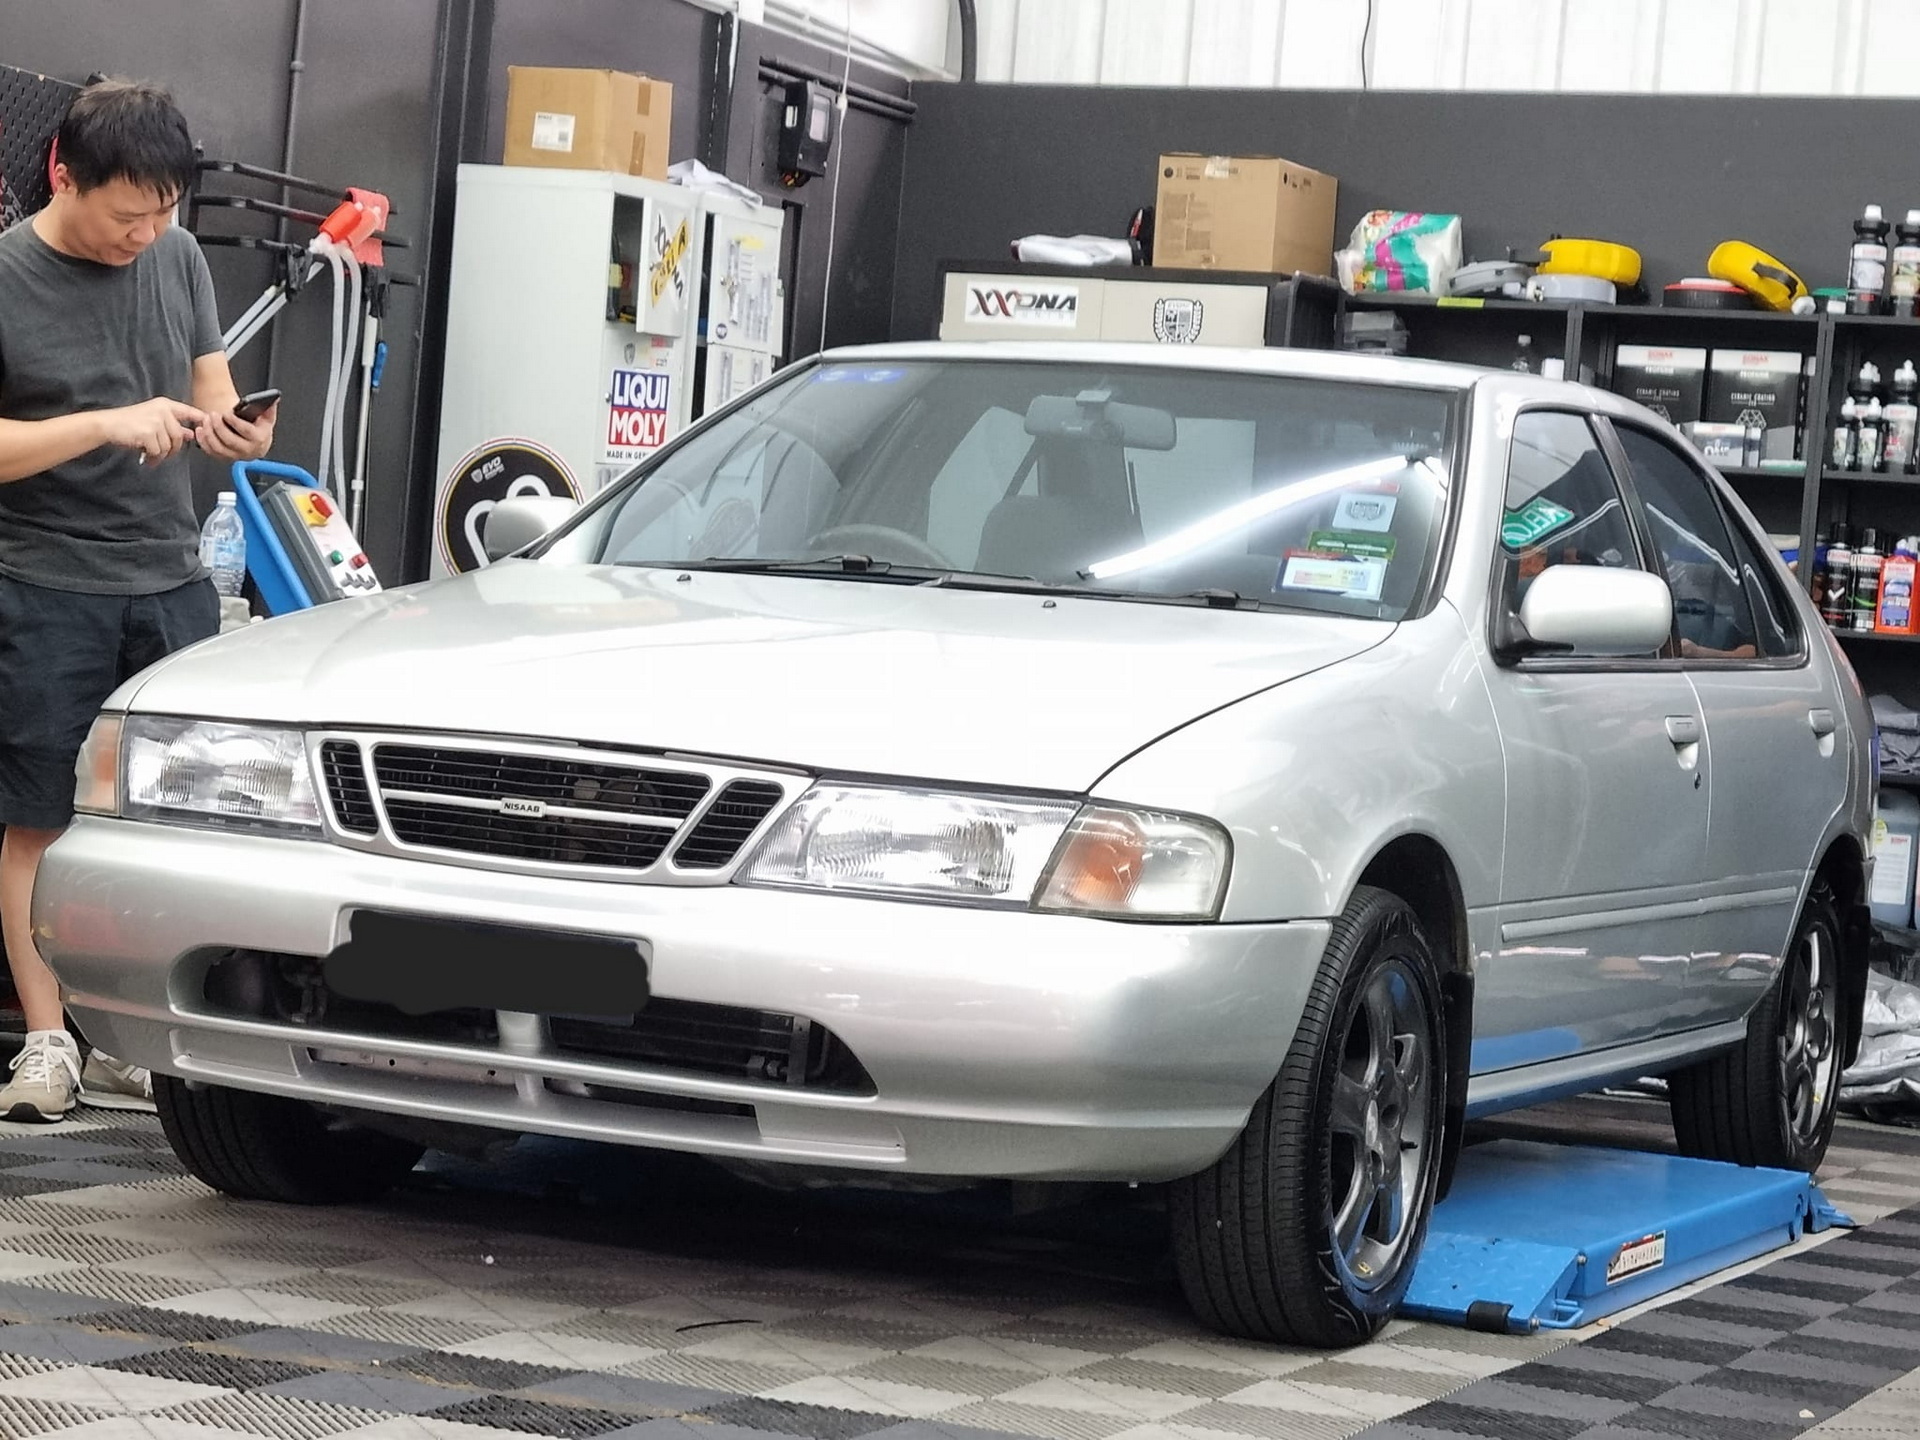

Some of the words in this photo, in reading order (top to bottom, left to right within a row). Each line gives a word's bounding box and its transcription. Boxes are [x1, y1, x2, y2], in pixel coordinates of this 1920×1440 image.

[613, 373, 667, 409] LIQUI
[611, 410, 666, 446] MOLY
[606, 450, 623, 459] MADE
[625, 451, 632, 459] IN
[482, 456, 501, 475] EVO
[503, 802, 540, 813] NISAAB
